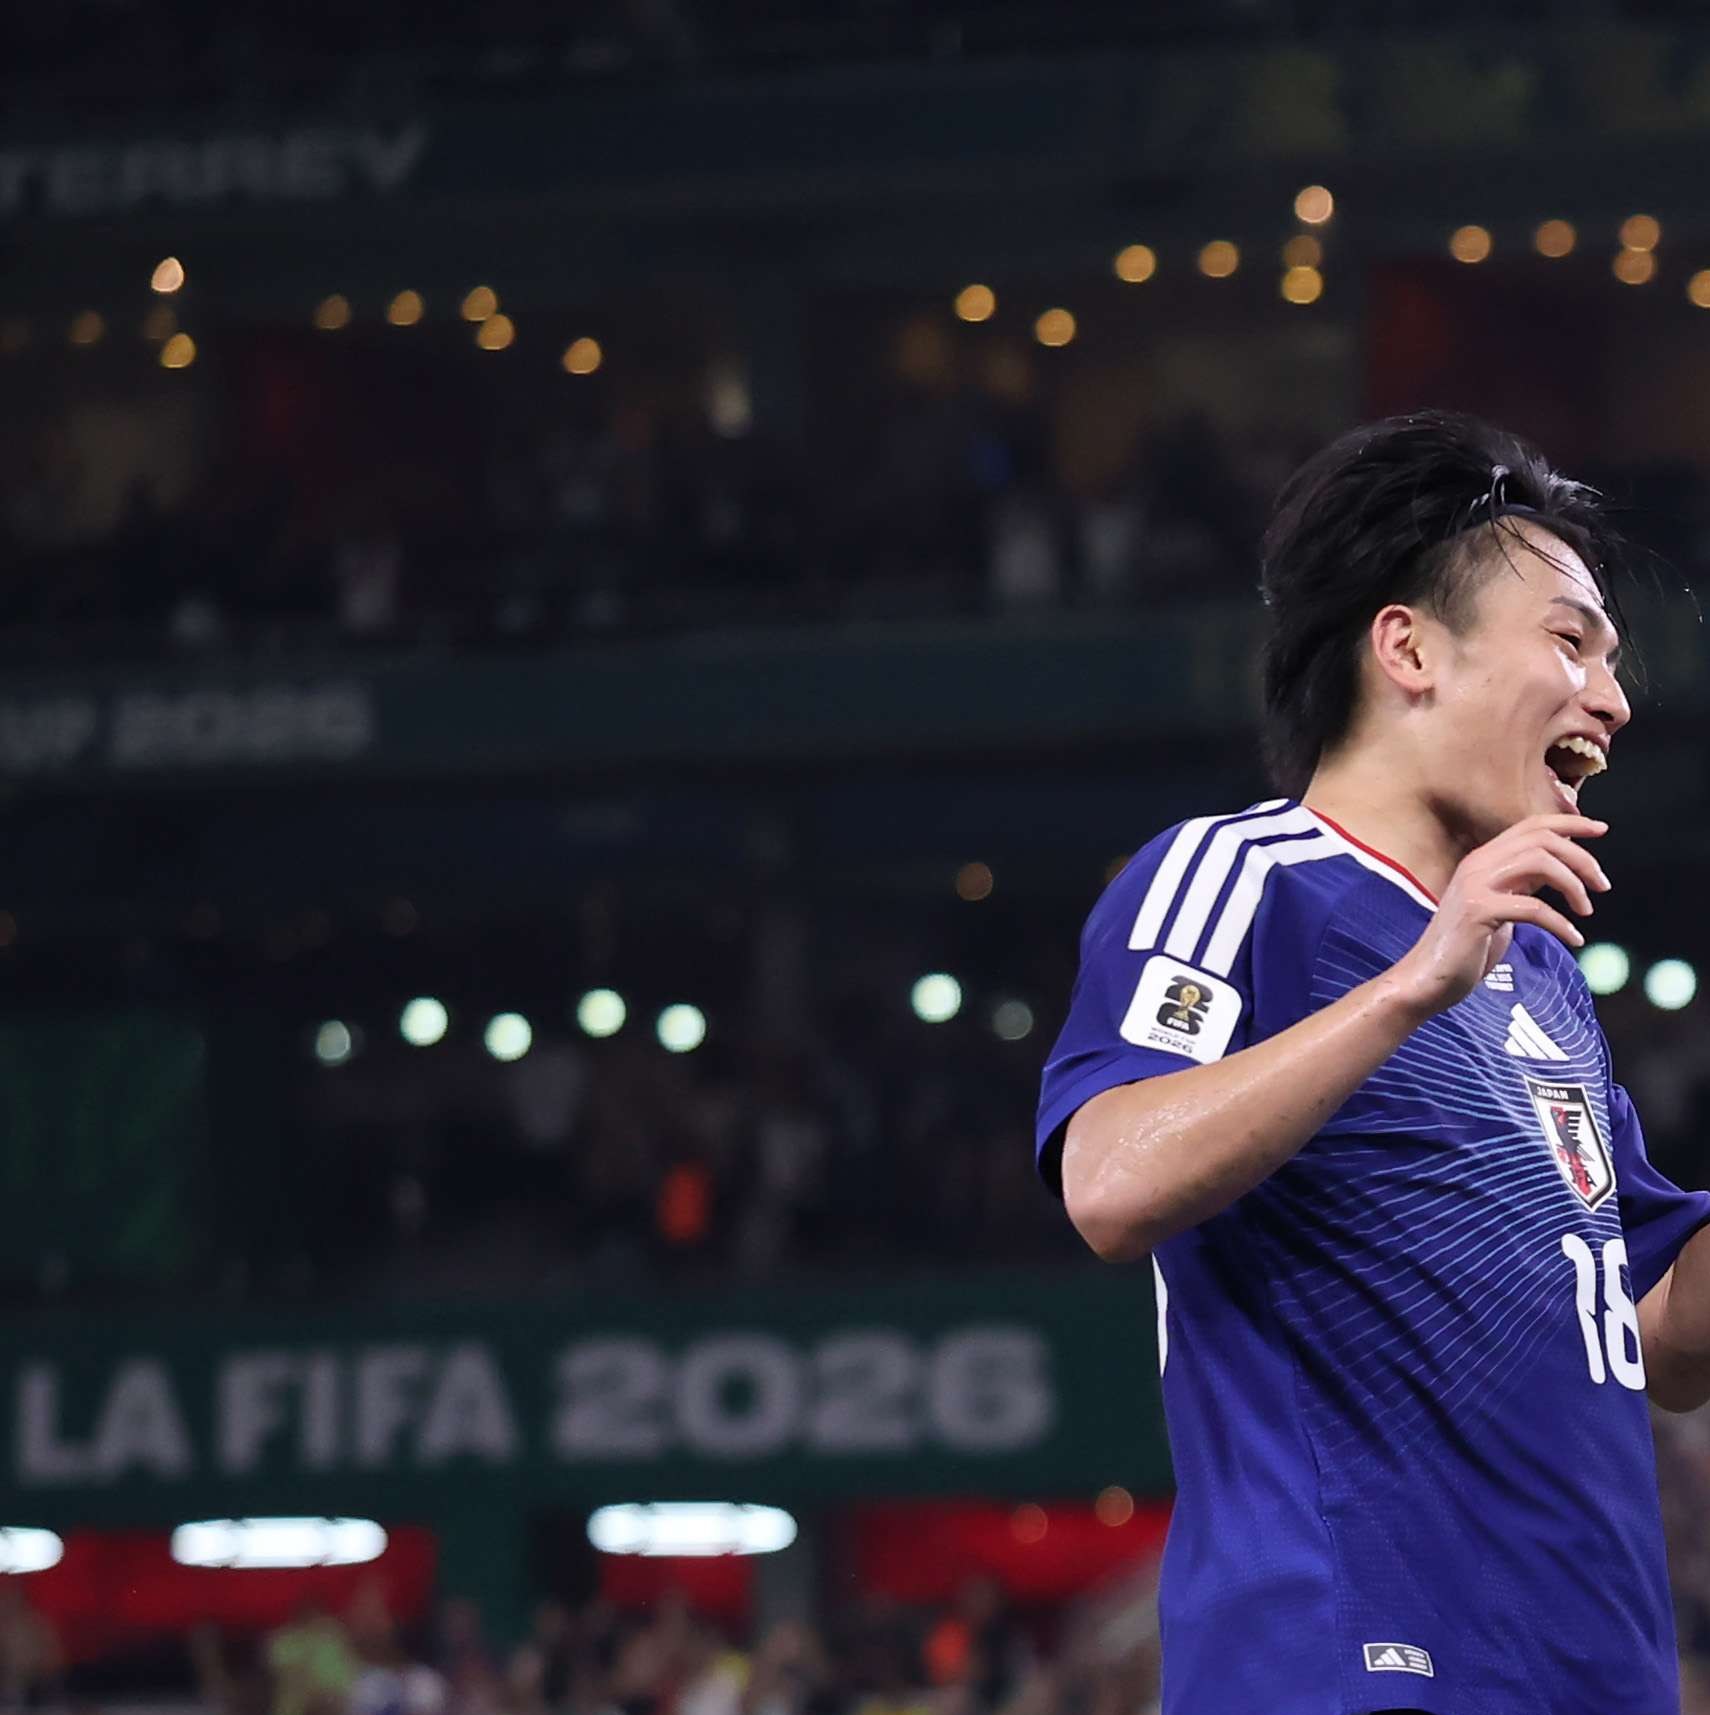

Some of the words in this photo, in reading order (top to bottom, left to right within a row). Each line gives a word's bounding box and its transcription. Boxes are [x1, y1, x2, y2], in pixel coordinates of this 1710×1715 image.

[1537, 1086, 1569, 1100] JAPAN
[1561, 1234, 1646, 1389] 18
[18, 1355, 191, 1482] LA
[218, 1340, 520, 1470] FIFA
[553, 1325, 1054, 1459] 2026
